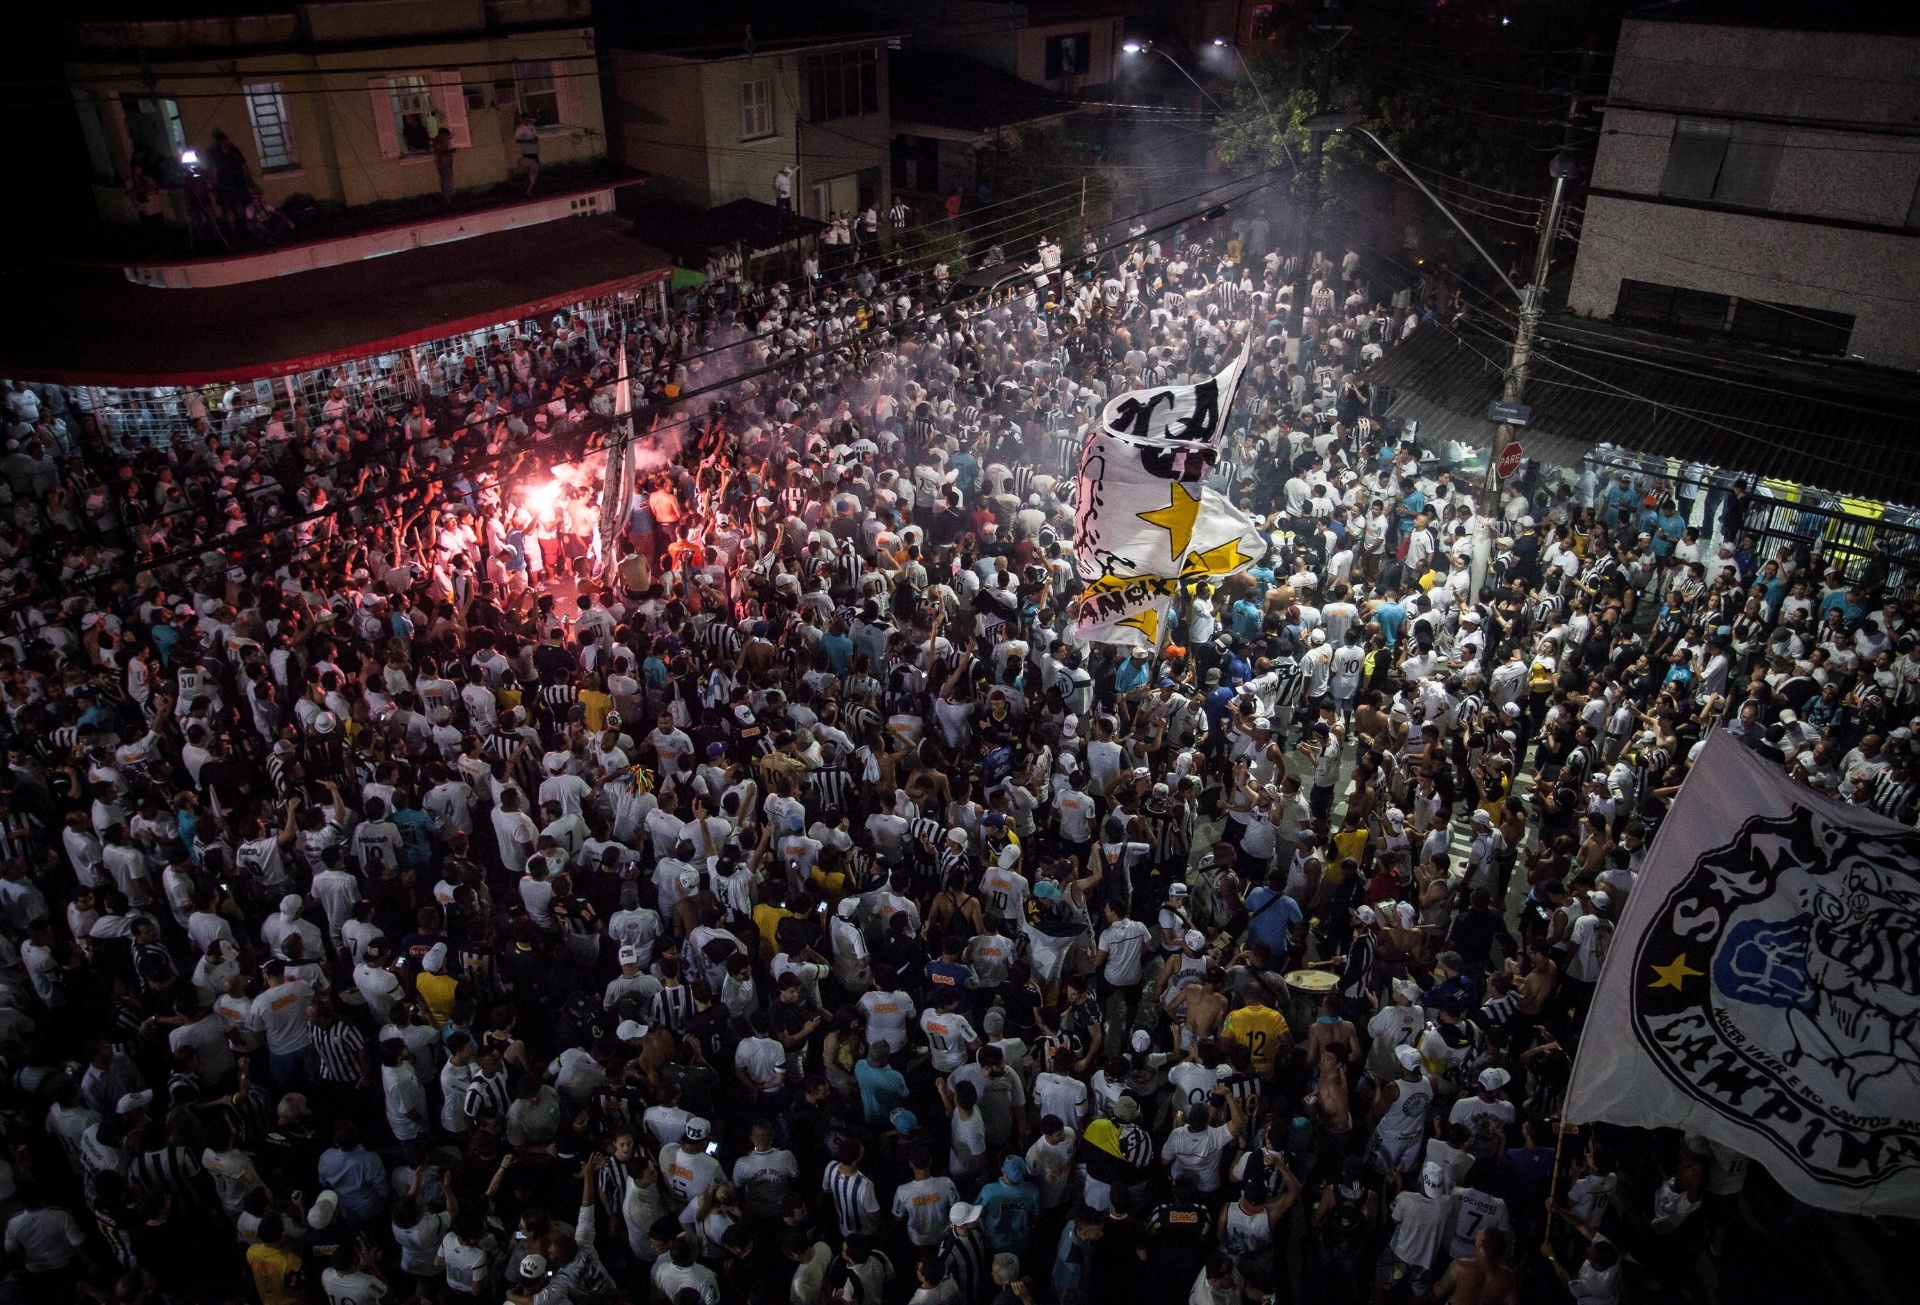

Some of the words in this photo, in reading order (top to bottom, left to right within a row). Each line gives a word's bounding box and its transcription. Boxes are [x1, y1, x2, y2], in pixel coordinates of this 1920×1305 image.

[1109, 285, 1118, 296] 10
[1318, 297, 1328, 307] 20
[1294, 443, 1300, 454] 7
[1500, 454, 1521, 468] PARE
[919, 478, 926, 491] 7
[1316, 509, 1324, 518] 11
[1344, 659, 1360, 674] 10
[741, 727, 761, 738] BMG
[993, 890, 1008, 911] 10
[348, 937, 358, 957] 7
[932, 973, 955, 986] BMG
[711, 1033, 722, 1054] 6
[929, 1033, 949, 1051] 11
[1247, 1031, 1267, 1057] 12
[1401, 1027, 1413, 1046] 7
[1785, 1076, 1802, 1088] E
[1800, 1085, 1825, 1105] NO
[1829, 1105, 1892, 1130] SANTOS
[668, 1163, 694, 1182] BMG
[1001, 1202, 1027, 1213] BMG
[1591, 1194, 1609, 1211] 10
[1170, 1210, 1199, 1224] BMG
[1468, 1211, 1484, 1237] 7
